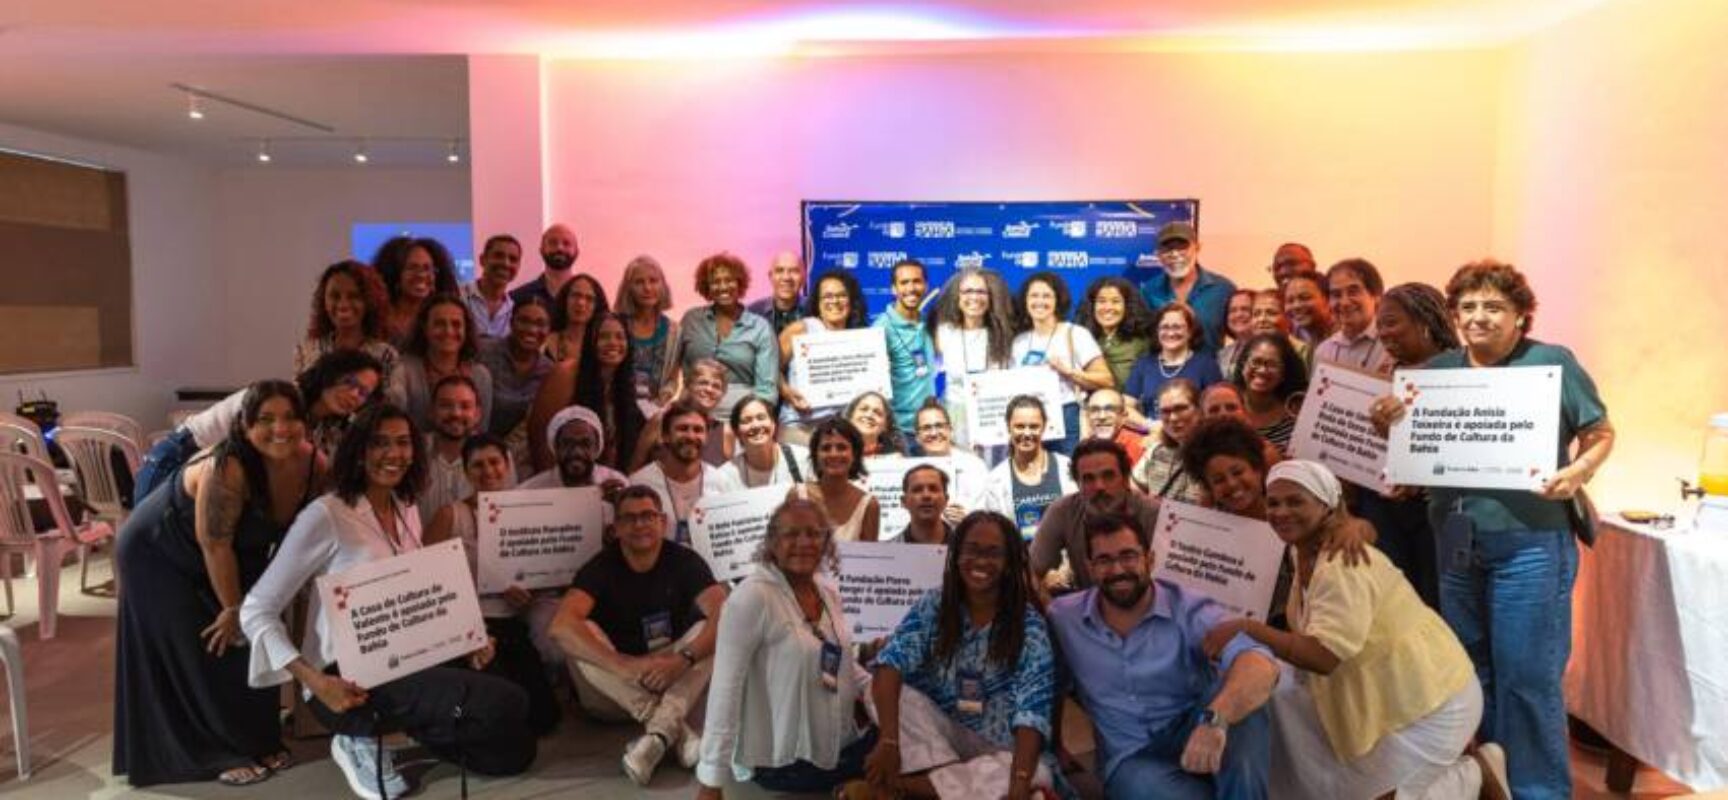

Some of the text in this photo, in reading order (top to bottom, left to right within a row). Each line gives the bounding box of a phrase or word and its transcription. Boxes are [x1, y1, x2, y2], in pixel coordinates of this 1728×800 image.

[1412, 408, 1420, 416] A
[1422, 406, 1470, 418] Fundação
[1412, 420, 1452, 429] Teixeira
[1464, 420, 1507, 430] apoiada
[1510, 420, 1534, 430] pelo
[1410, 432, 1514, 442] Fundo de Cultura da
[1410, 444, 1440, 454] Bahia
[351, 584, 442, 618] A Casa de Cultura de
[842, 596, 862, 604] undo
[354, 612, 391, 630] Valente
[392, 608, 398, 618] é
[438, 592, 458, 606] pelo
[842, 606, 860, 614] ahia
[357, 606, 448, 642] Fundo de Cultura da
[360, 638, 388, 654] Bahia
